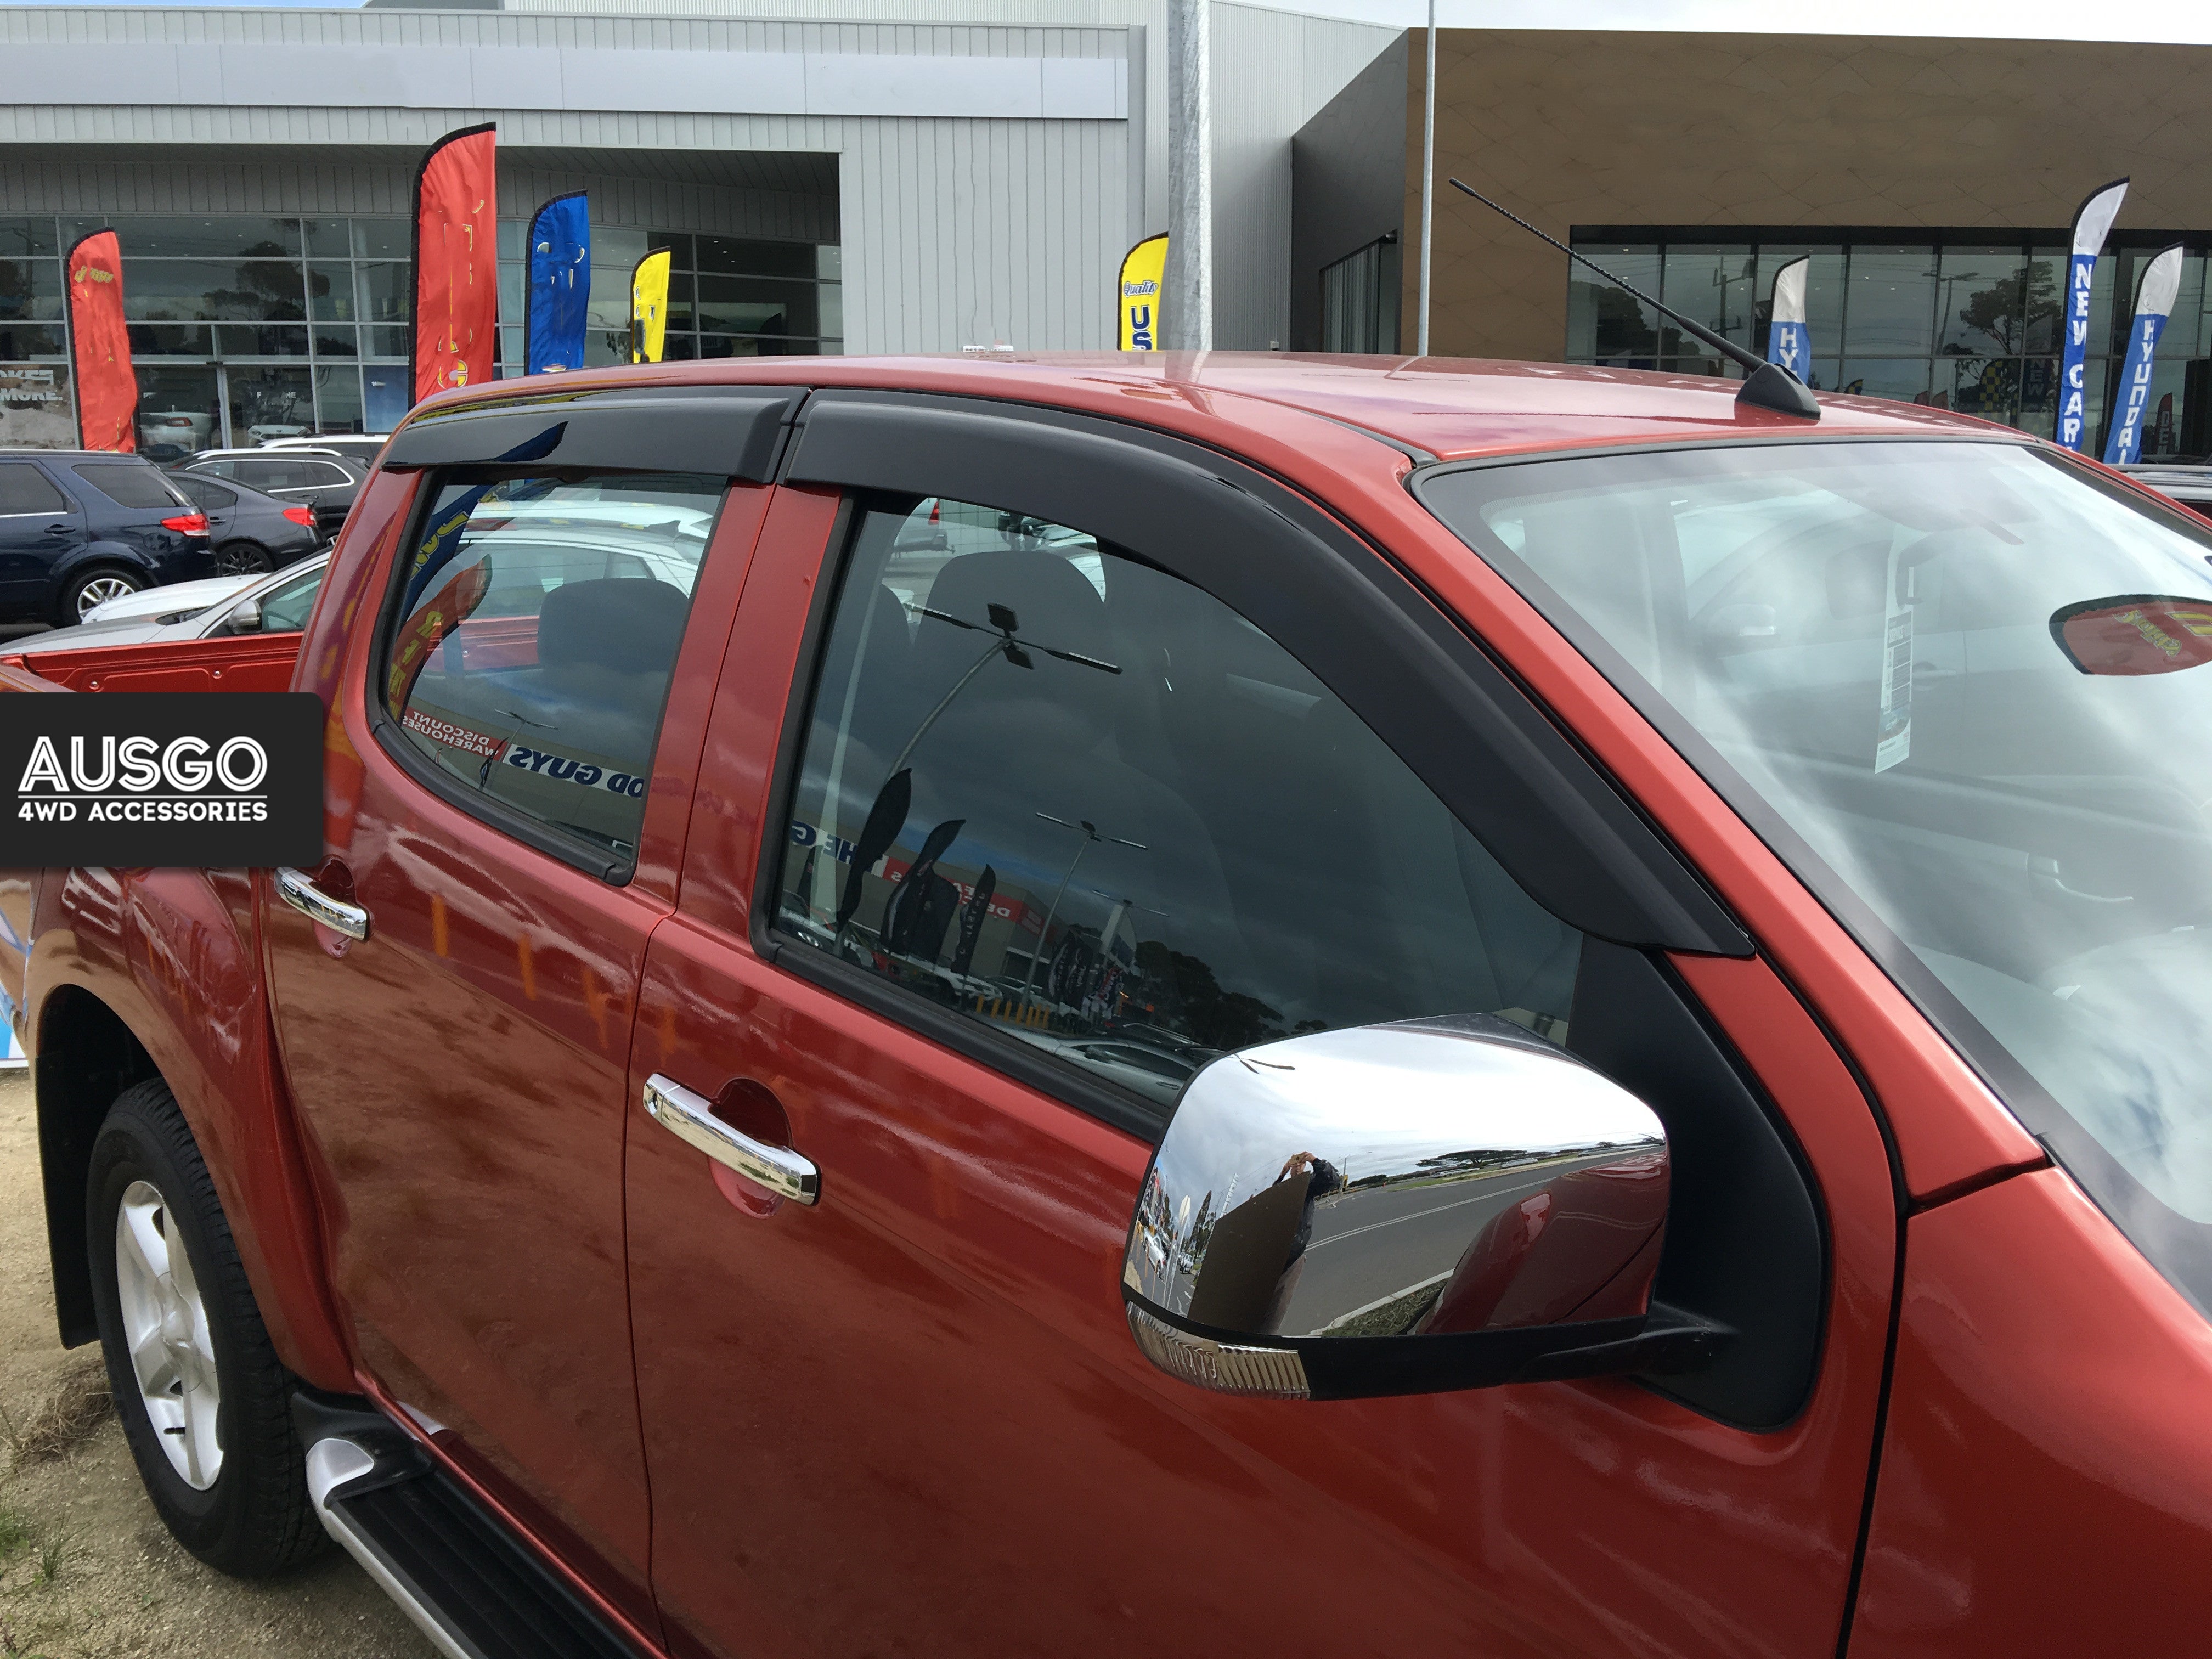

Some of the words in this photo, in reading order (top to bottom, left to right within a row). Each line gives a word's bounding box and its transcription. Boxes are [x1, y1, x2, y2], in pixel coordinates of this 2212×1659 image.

[1124, 280, 1159, 298] Quality
[1779, 328, 1799, 374] HY
[2064, 364, 2084, 449] CAR
[2118, 320, 2155, 465] HYUNDAI
